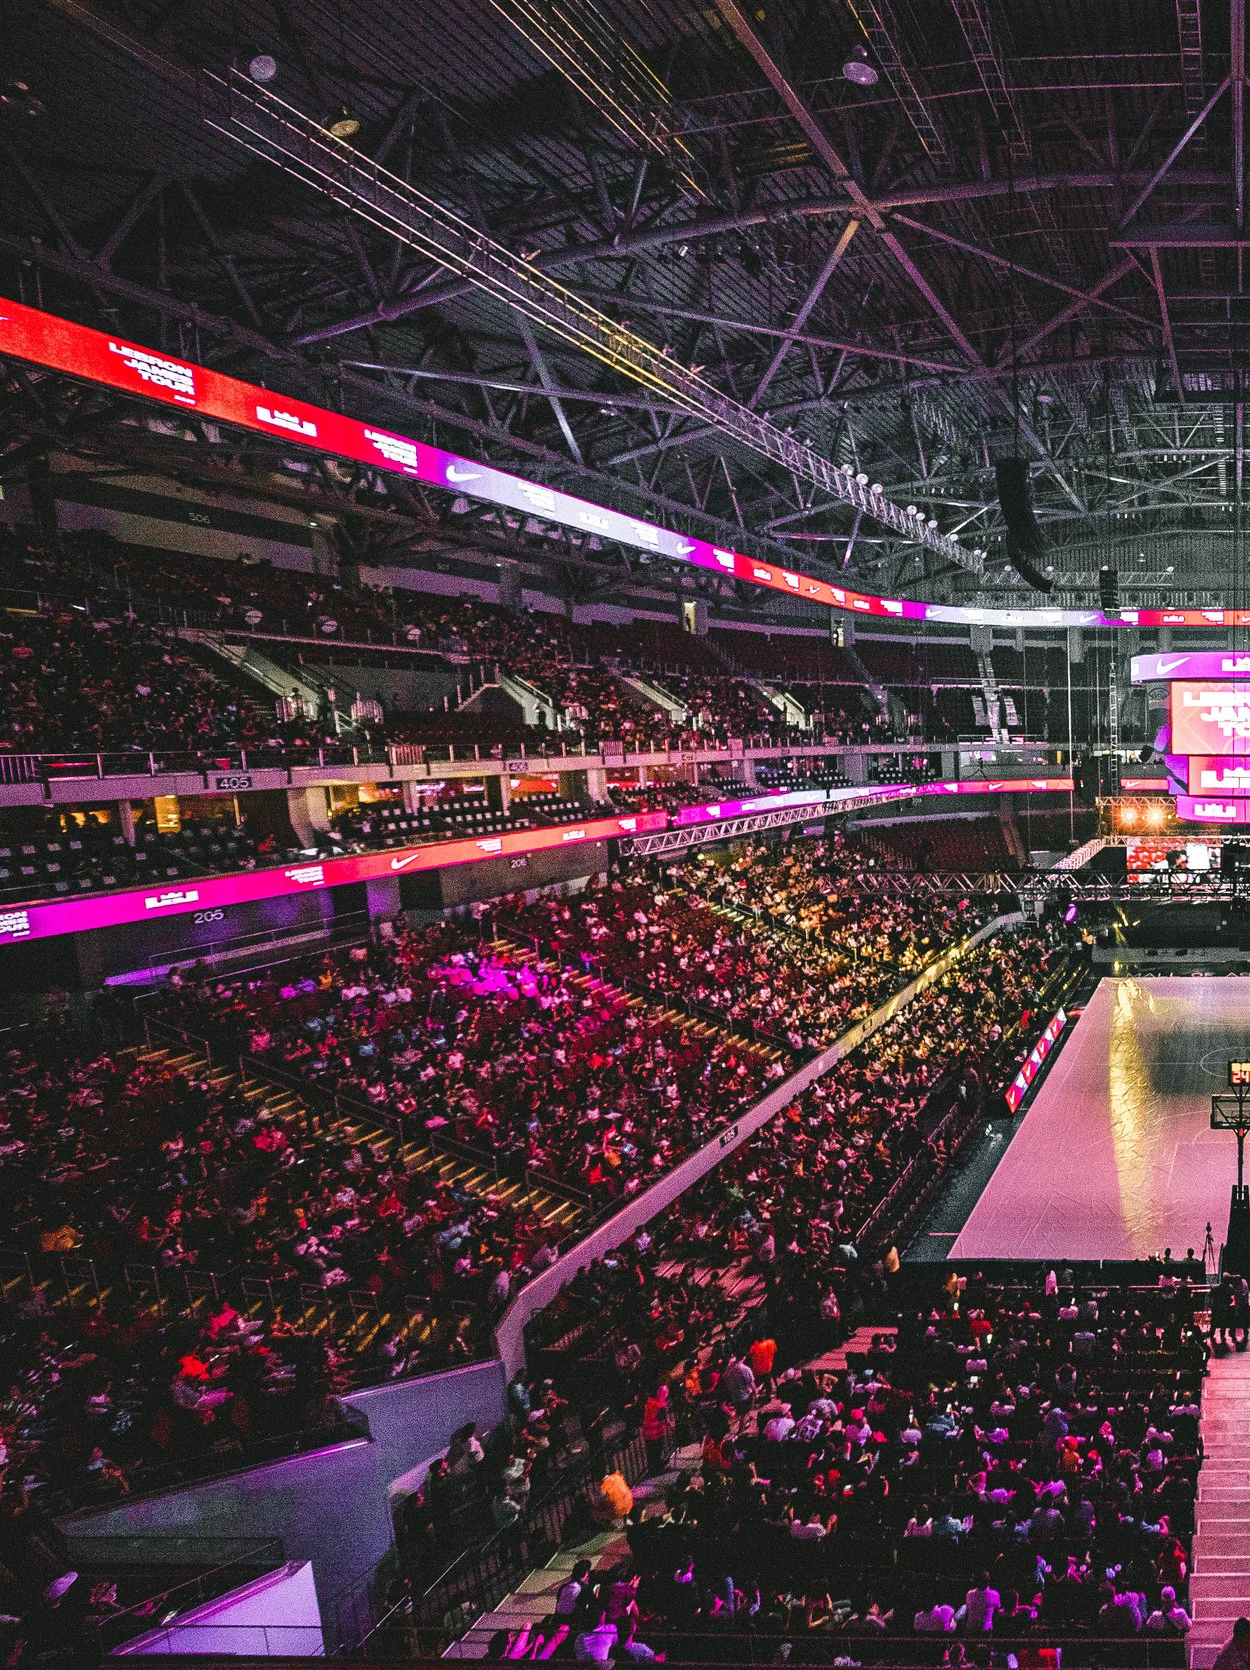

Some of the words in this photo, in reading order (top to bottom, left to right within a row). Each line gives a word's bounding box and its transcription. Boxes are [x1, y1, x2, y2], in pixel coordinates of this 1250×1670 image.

[137, 368, 196, 396] TOUR
[220, 777, 249, 789] 405
[193, 909, 224, 924] 205
[1232, 1071, 1250, 1084] 24
